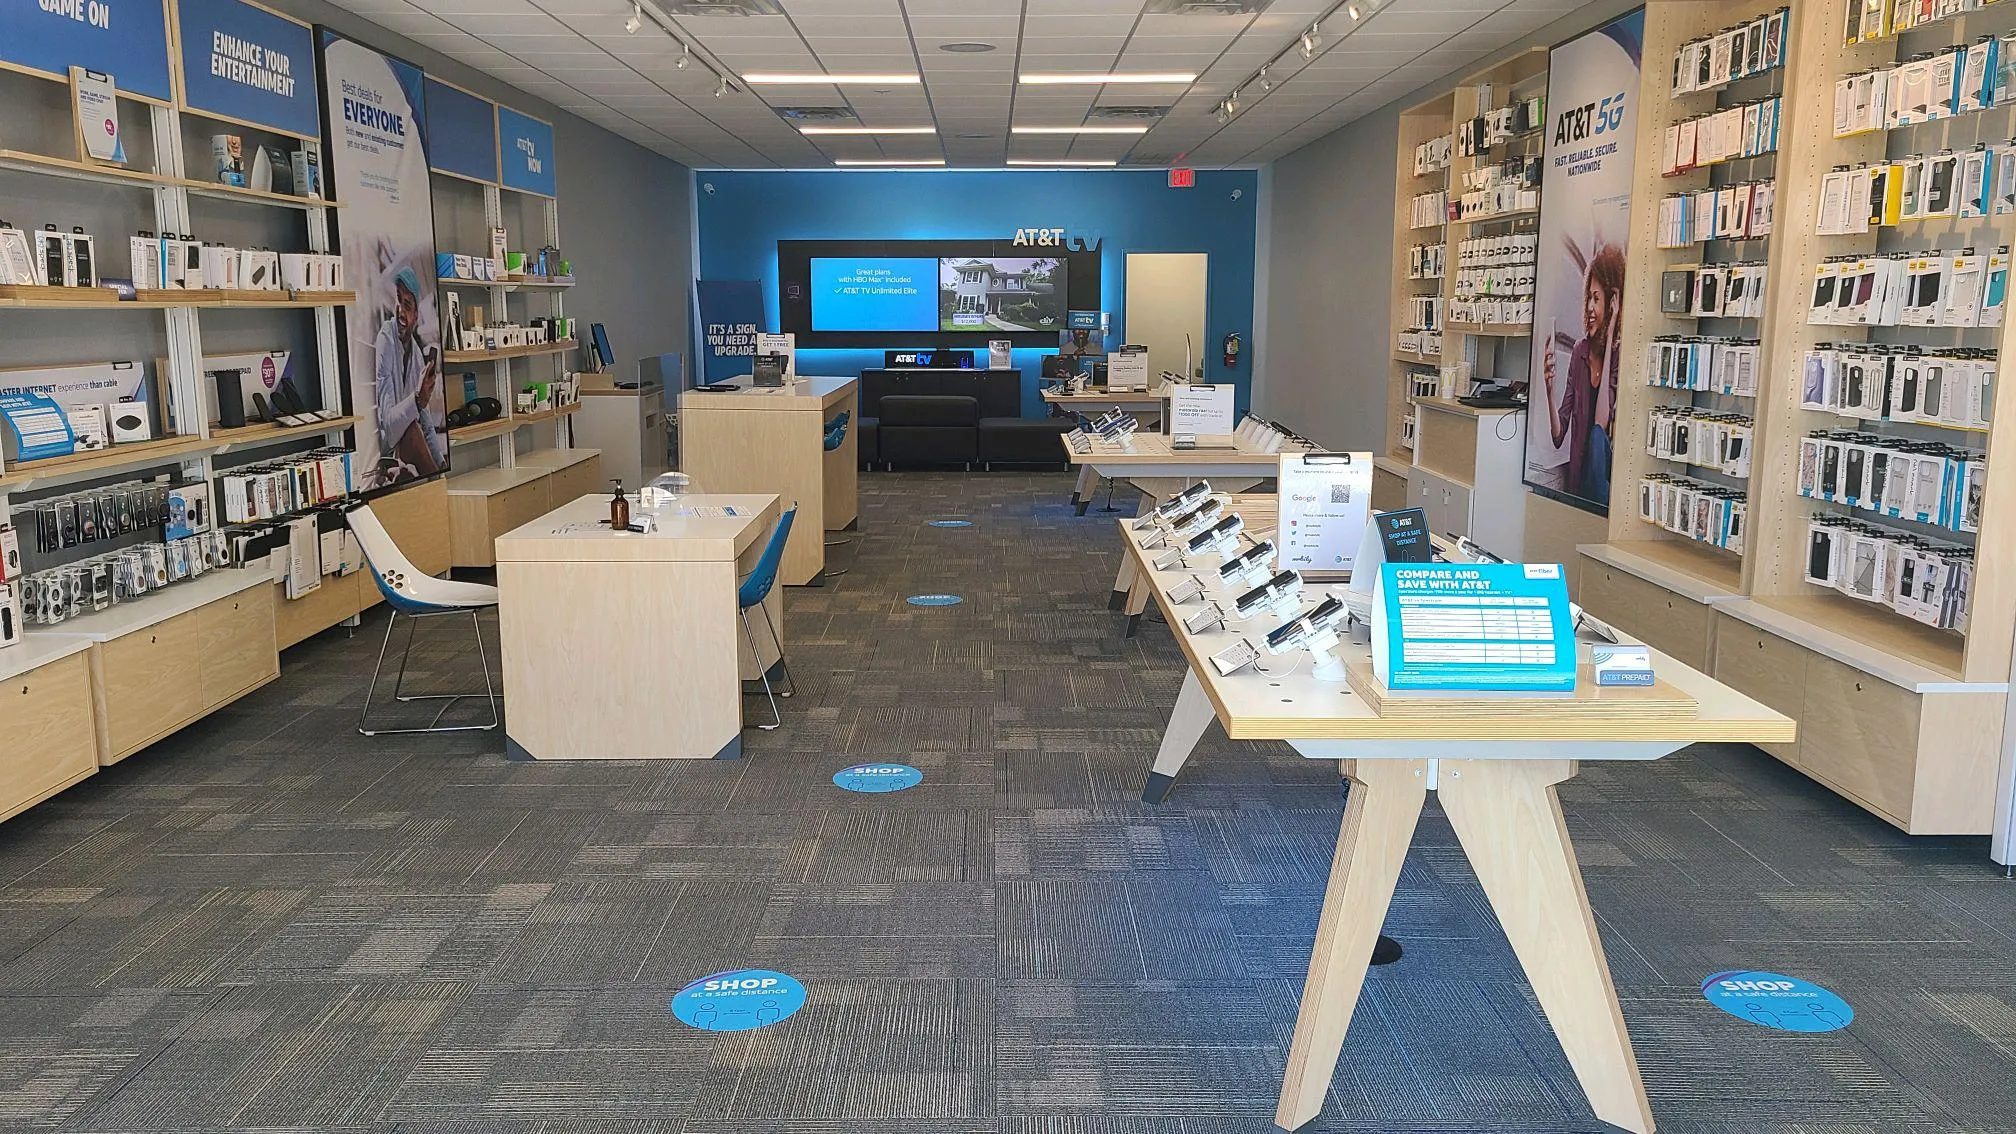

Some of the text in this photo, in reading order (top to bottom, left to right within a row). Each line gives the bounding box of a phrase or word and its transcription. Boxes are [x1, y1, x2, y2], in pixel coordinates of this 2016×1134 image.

[88, 0, 109, 29] ON
[213, 30, 290, 76] ENHANCE YOUR
[211, 52, 295, 98] ENTERTAINMENT
[341, 79, 382, 104] Best deals for
[343, 97, 405, 137] EVERYONE
[1553, 92, 1625, 148] AT&T 5G
[1554, 156, 1568, 168] FAST.
[1567, 159, 1602, 177] NATIONWIDE
[1172, 169, 1192, 187] EXIT
[1012, 225, 1101, 252] AT&T tv
[874, 268, 891, 277] plans
[709, 324, 758, 334] IT'S A SIGN.
[707, 335, 757, 346] YOU NEED A
[714, 346, 757, 356] UPGRADE.
[895, 352, 932, 365] AT&T tv
[22, 384, 56, 394] INTERNET
[57, 384, 89, 393] experience
[89, 380, 102, 389] than
[103, 378, 118, 388] cable
[1291, 494, 1316, 503] Google
[1399, 517, 1412, 527] AT&T
[1388, 532, 1400, 540] SHOP
[1396, 537, 1417, 546] DISTANCE
[1396, 569, 1480, 580] COMPARE AND
[1397, 579, 1491, 590] SAVE WITH AT&T
[1602, 673, 1651, 681] AT&T PREPAID
[703, 978, 778, 991] SHOP
[1720, 980, 1796, 991] SHOP
[741, 988, 788, 996] distance
